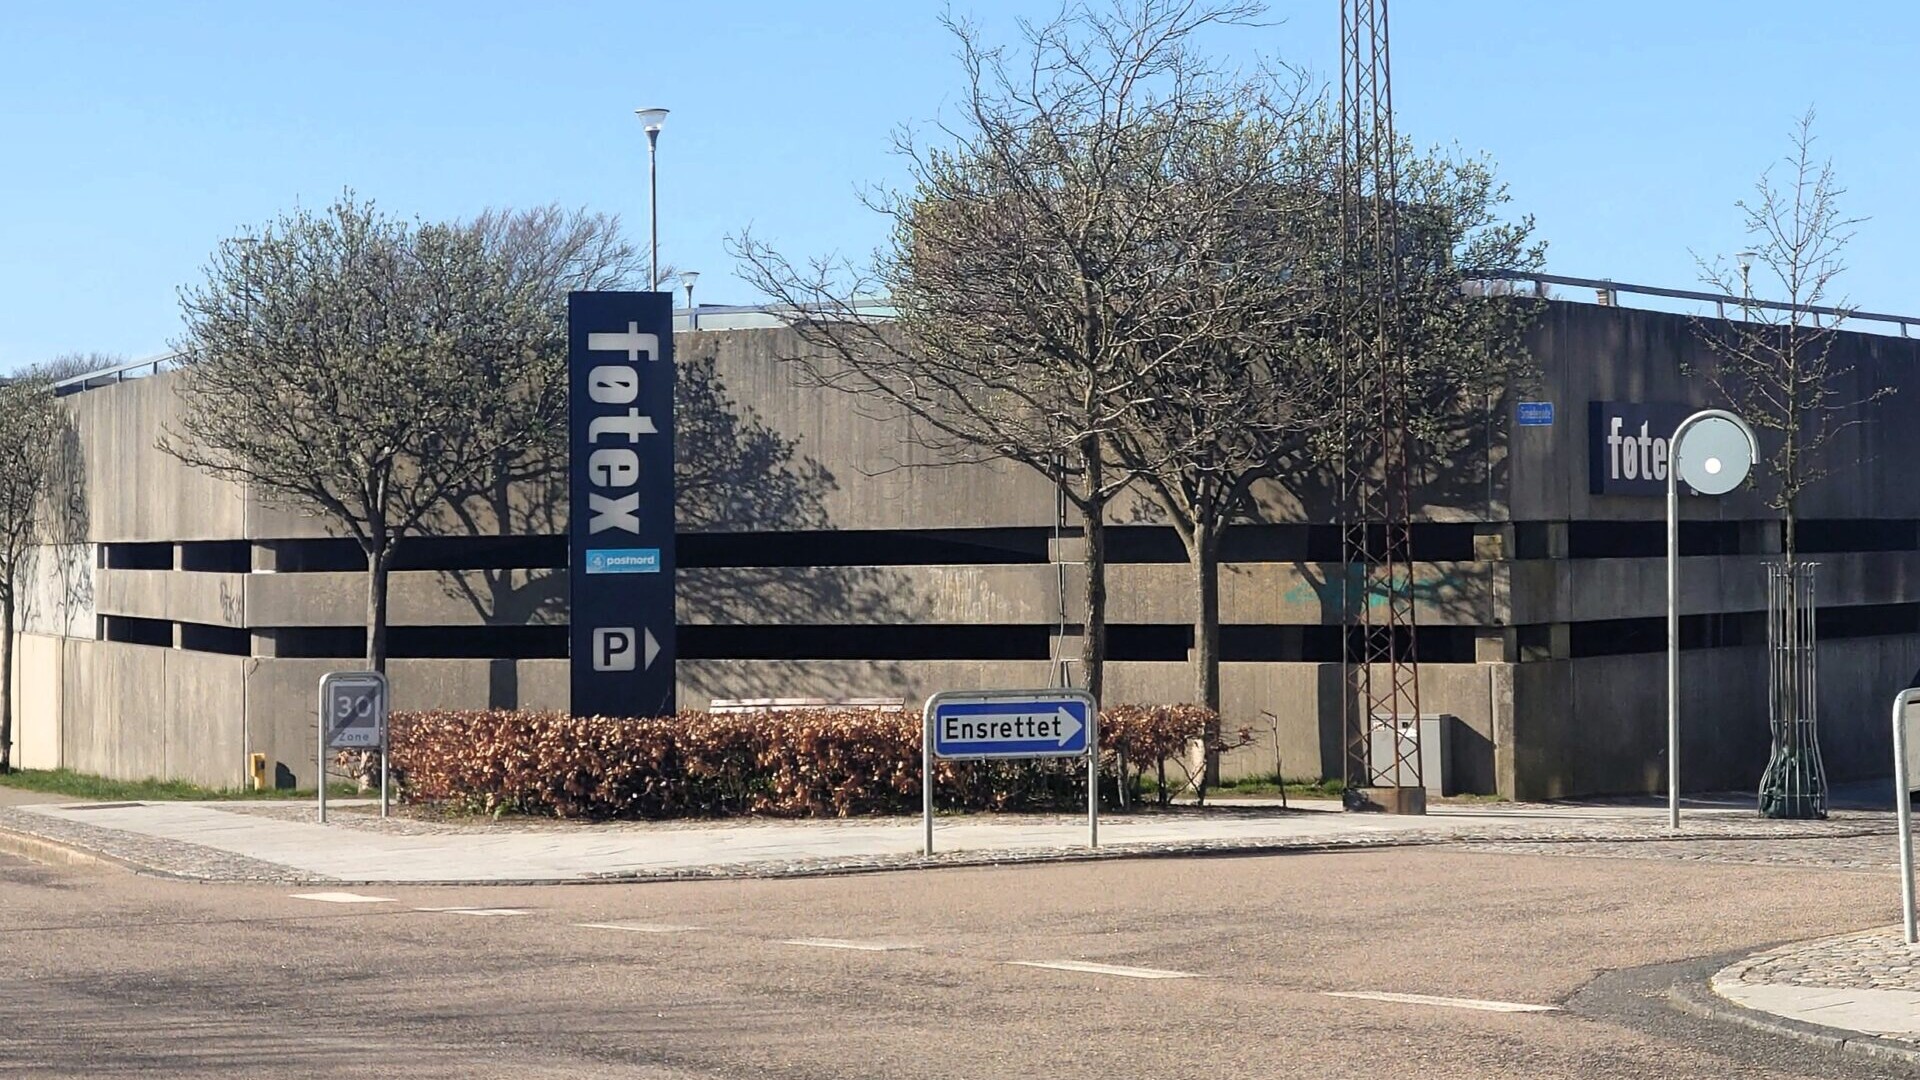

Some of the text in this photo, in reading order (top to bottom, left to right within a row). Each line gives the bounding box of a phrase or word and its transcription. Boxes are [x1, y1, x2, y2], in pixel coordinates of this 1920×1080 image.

[588, 321, 659, 535] føtex
[1607, 417, 1683, 480] føte
[606, 555, 656, 566] postnord
[603, 632, 628, 666] P
[337, 696, 372, 717] 30
[339, 733, 369, 741] Zone
[945, 715, 1061, 740] Ensrettet
